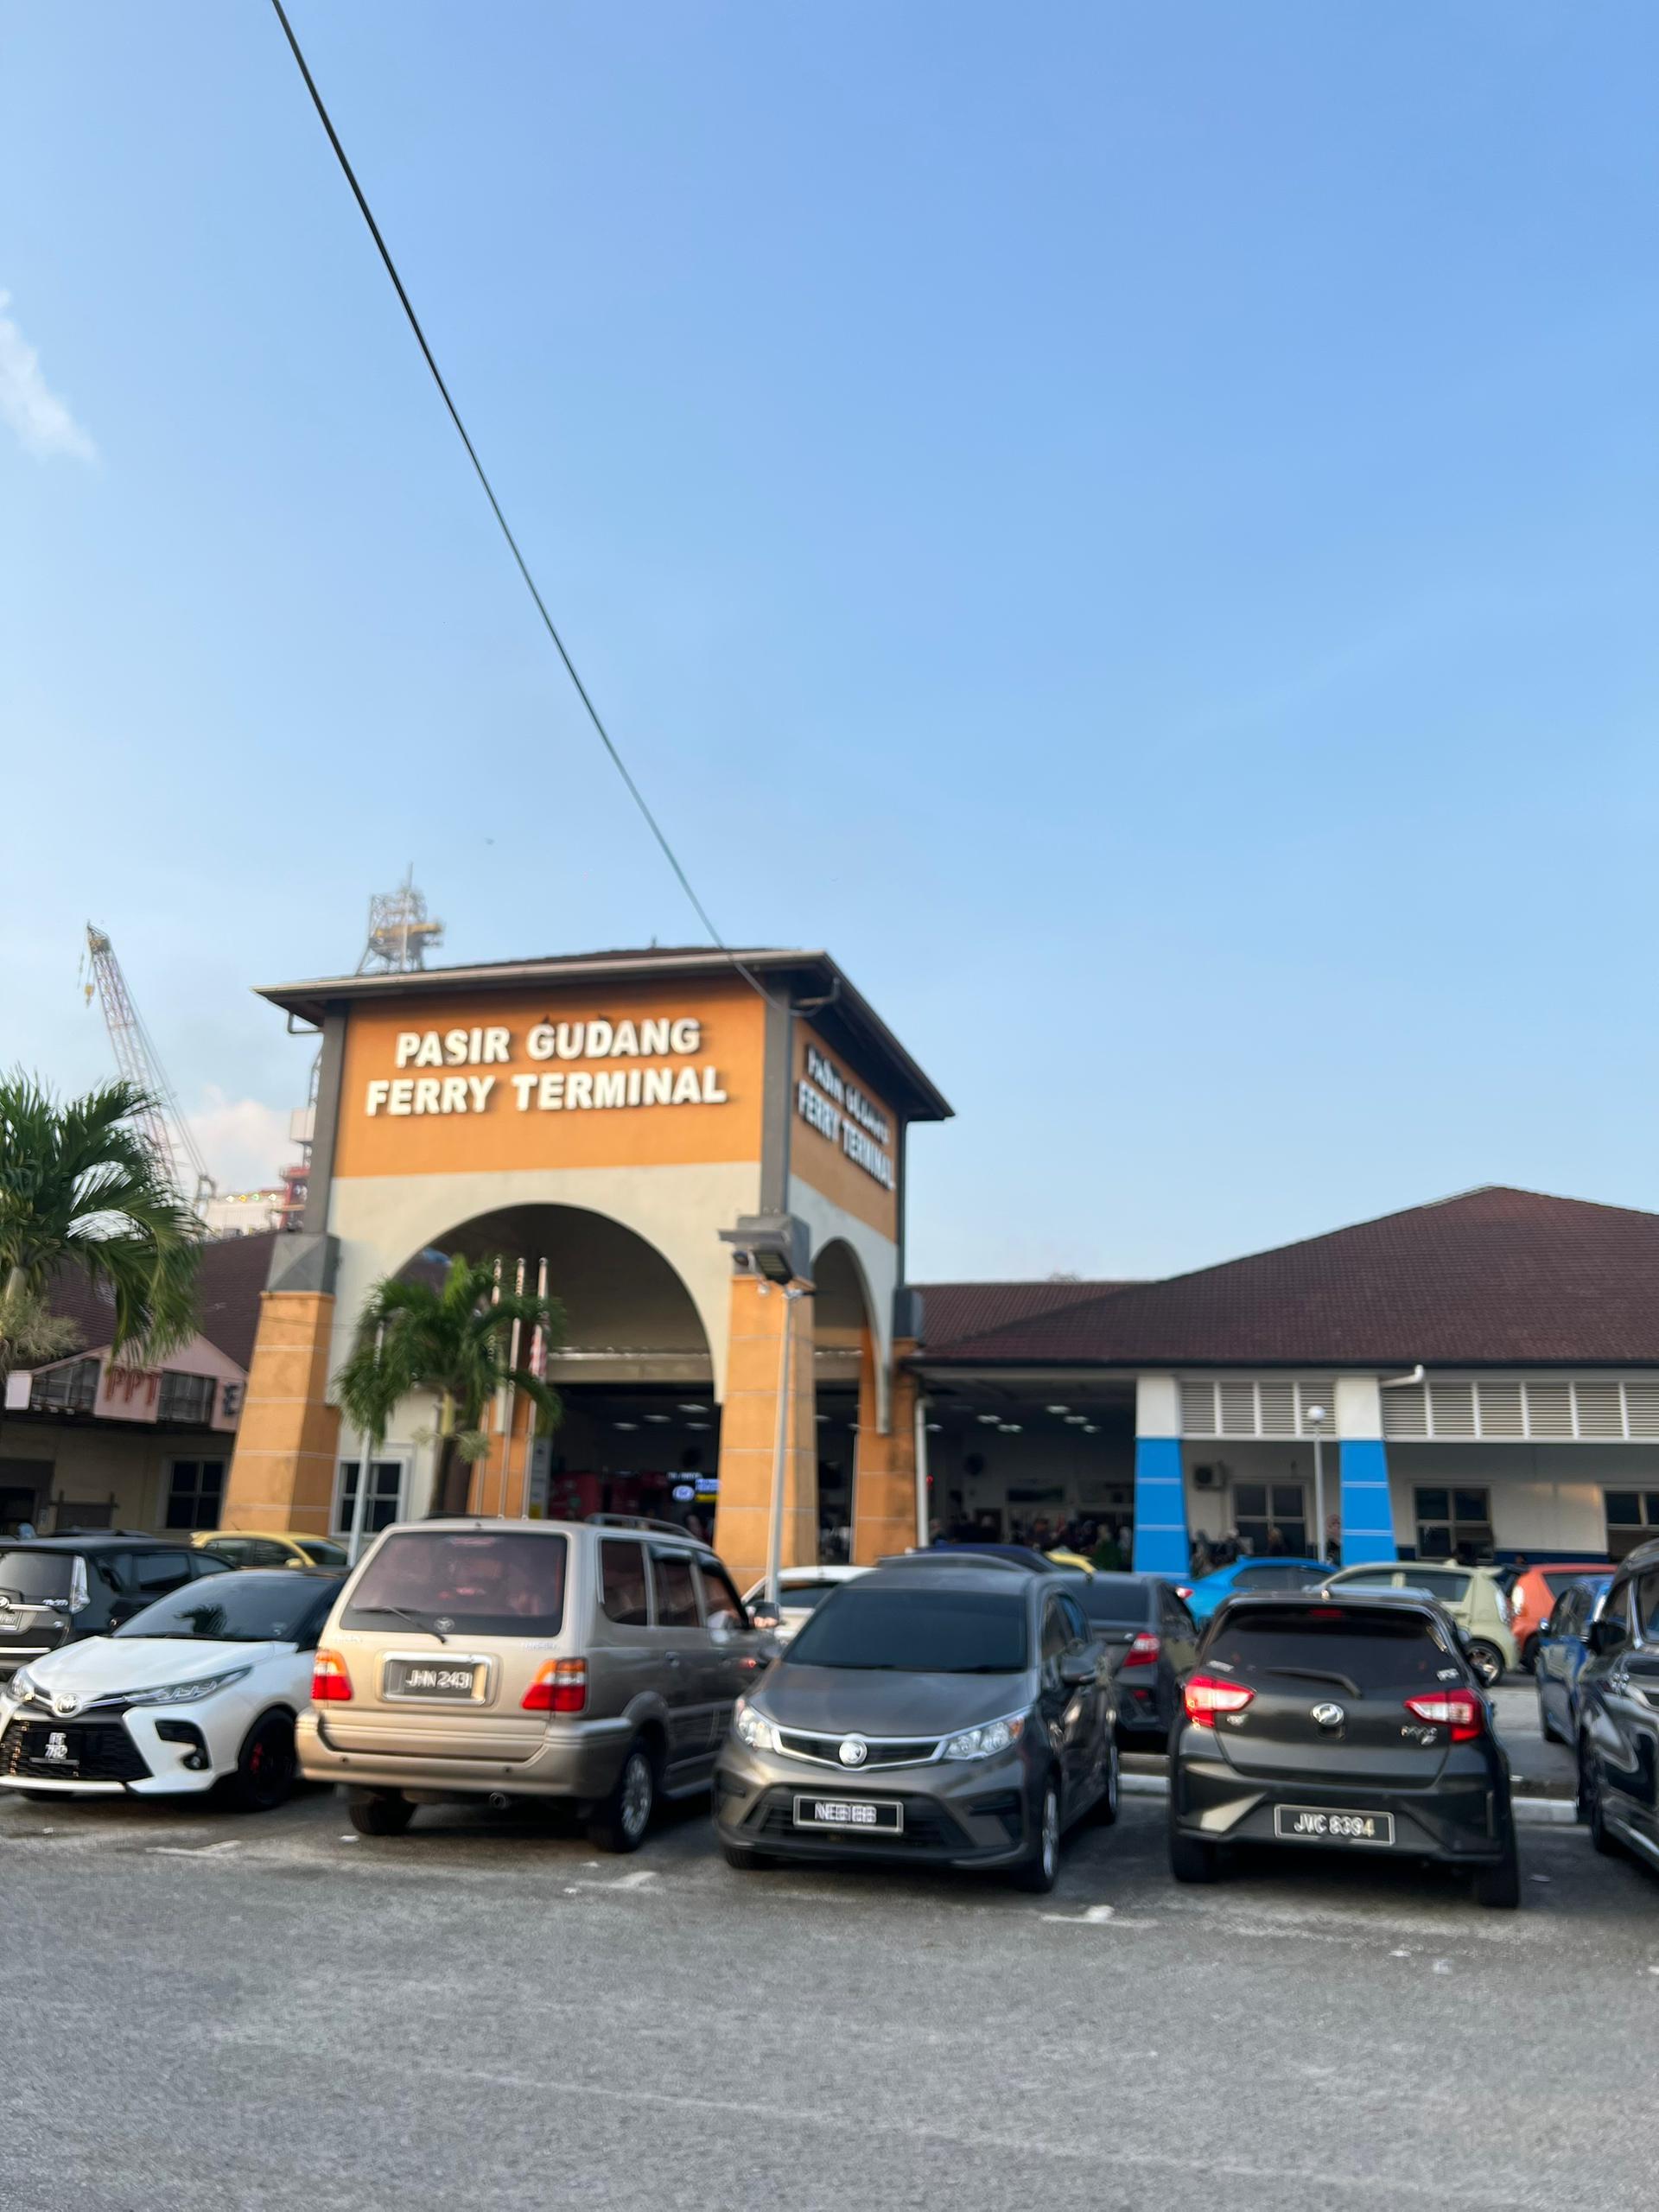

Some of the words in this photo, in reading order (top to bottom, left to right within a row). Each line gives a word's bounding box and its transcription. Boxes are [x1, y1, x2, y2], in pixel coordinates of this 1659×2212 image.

[395, 1026, 511, 1069] PASIR
[526, 1017, 701, 1061] GUDANG
[365, 1075, 496, 1116] FERRY
[511, 1065, 728, 1112] TERMINAL
[798, 1079, 842, 1144] FERRY
